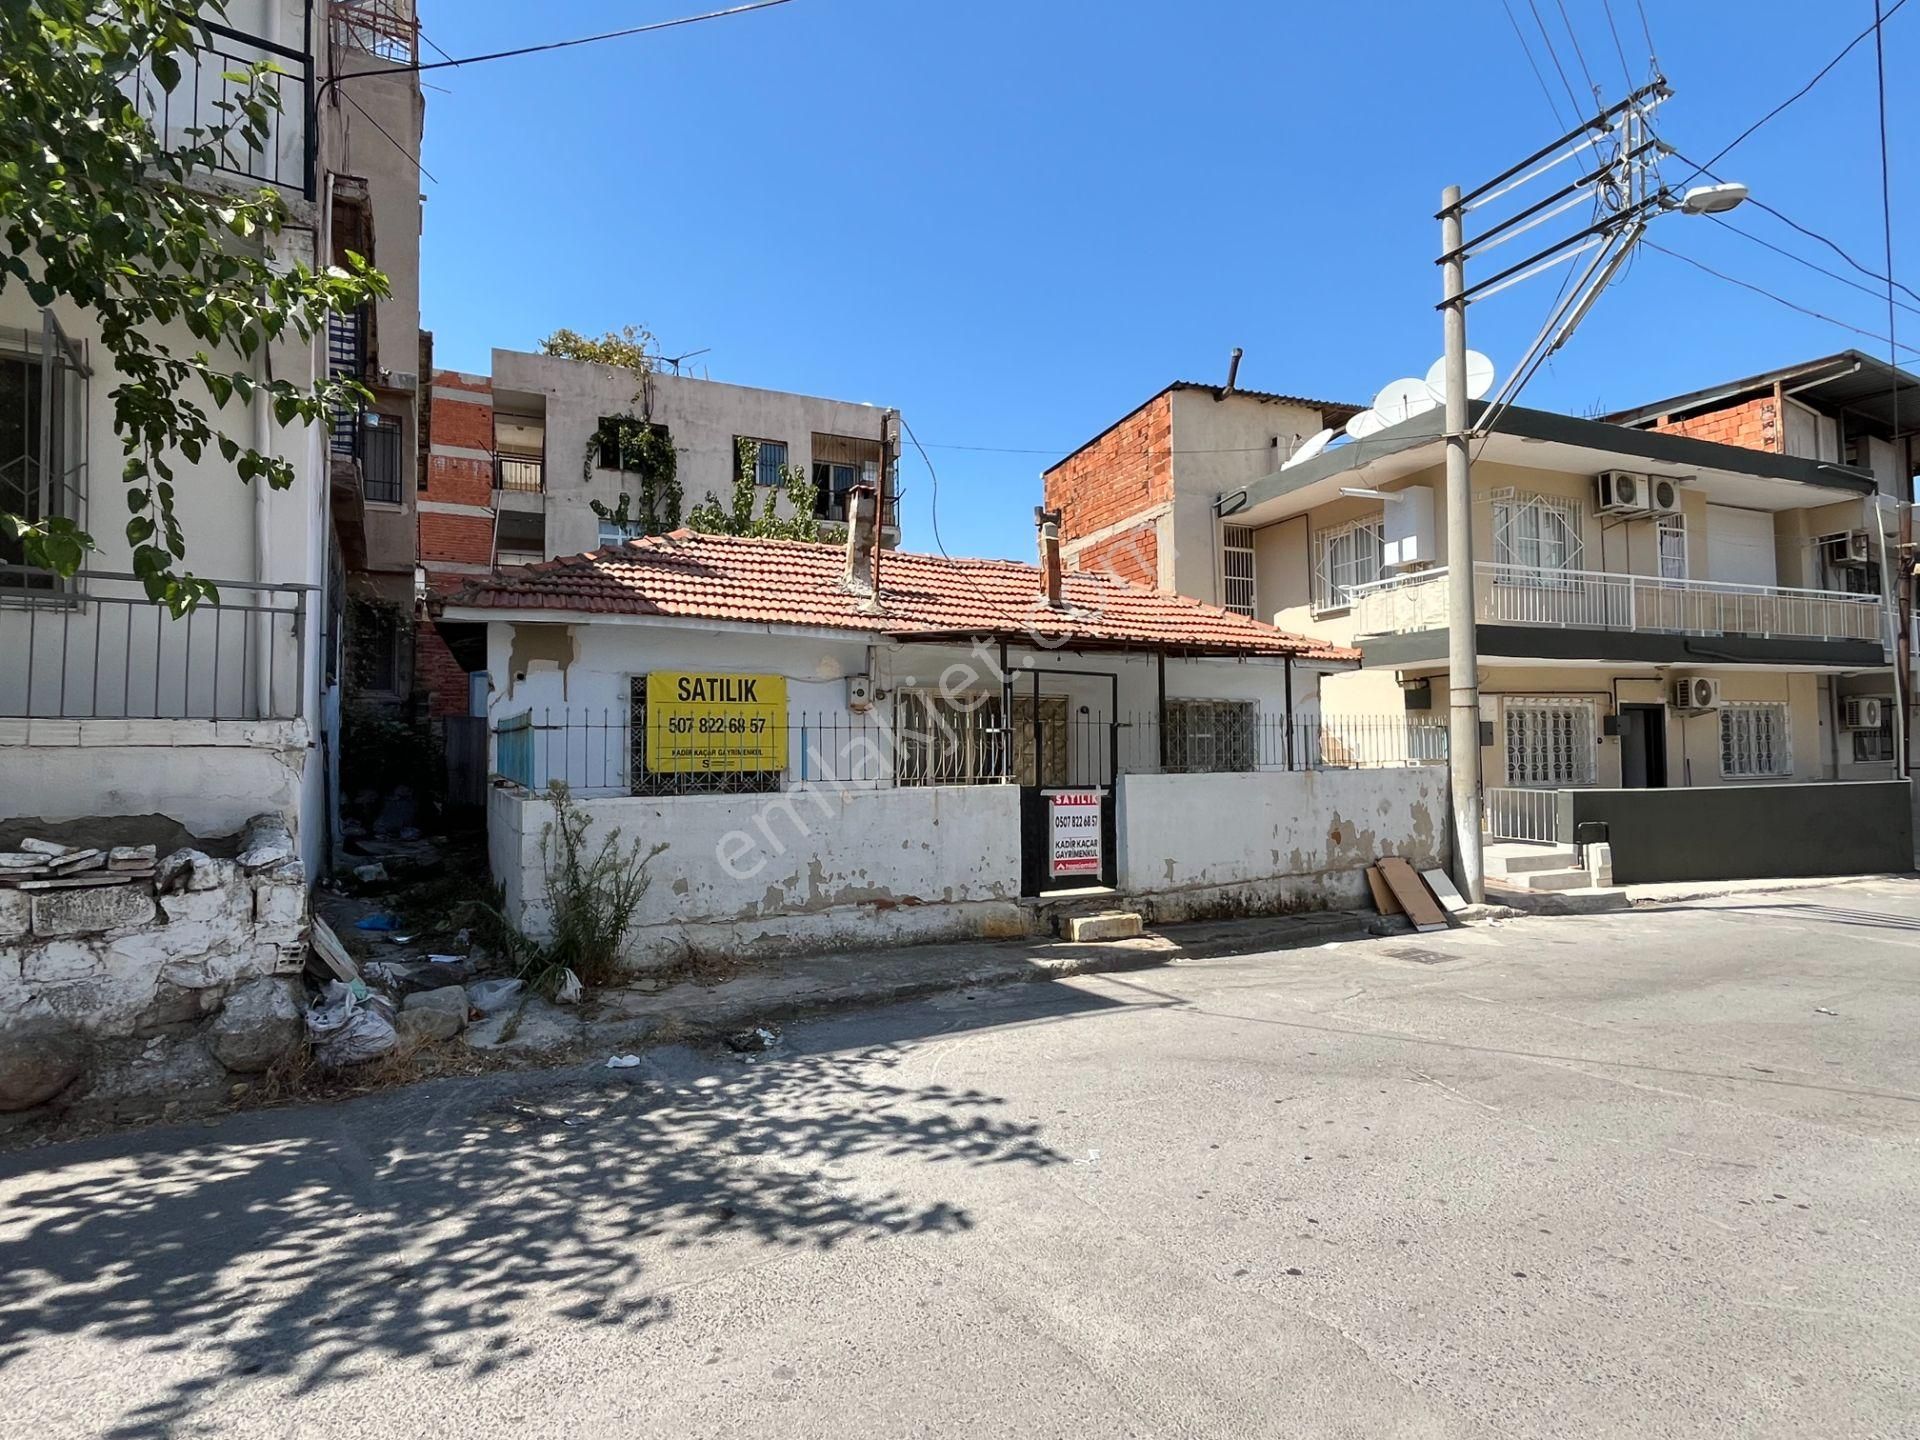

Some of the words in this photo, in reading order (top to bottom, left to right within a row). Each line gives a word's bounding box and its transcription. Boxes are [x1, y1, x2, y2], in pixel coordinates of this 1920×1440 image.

[677, 677, 758, 702] SATILIK
[668, 717, 694, 734] 507
[699, 717, 724, 734] 822
[729, 717, 745, 734] 68
[750, 718, 766, 734] 57
[1055, 815, 1071, 828] 0507
[1072, 815, 1083, 828] 822
[1084, 815, 1091, 827] 68
[1092, 815, 1098, 827] 57
